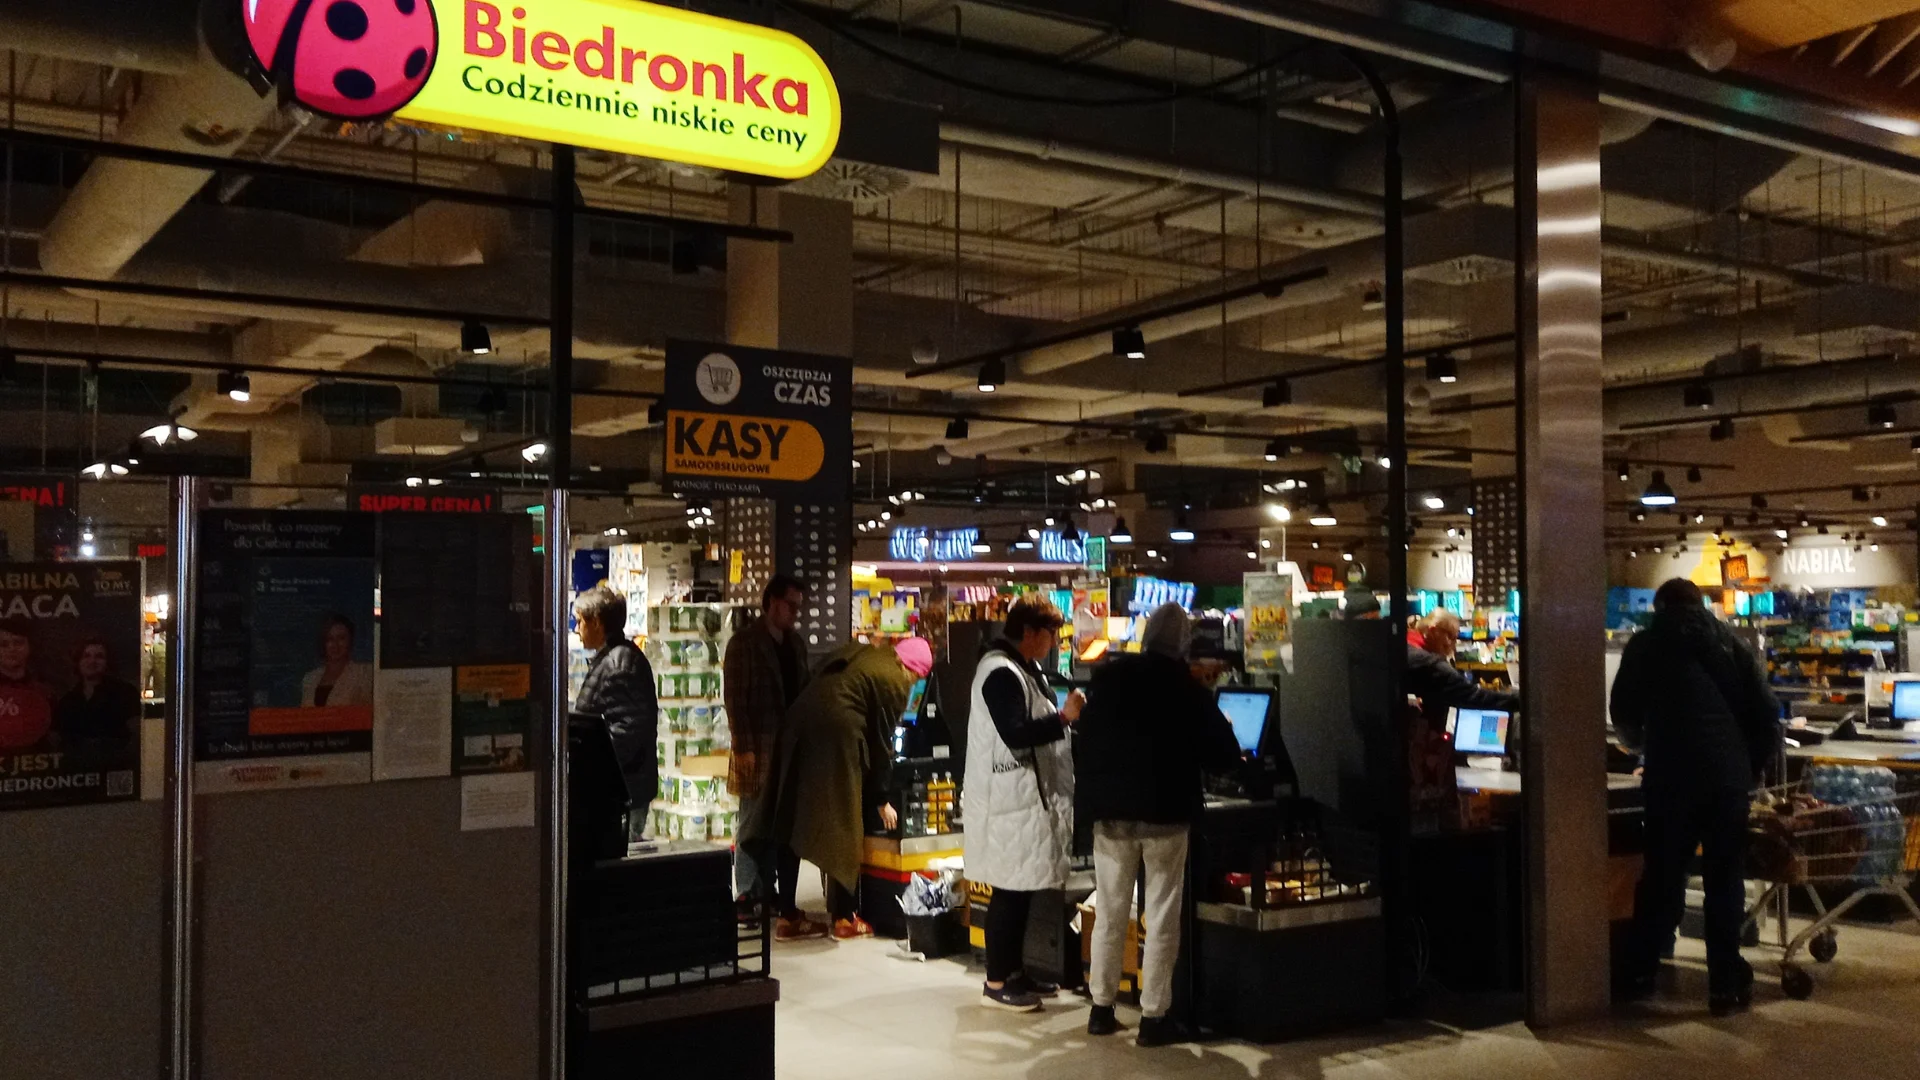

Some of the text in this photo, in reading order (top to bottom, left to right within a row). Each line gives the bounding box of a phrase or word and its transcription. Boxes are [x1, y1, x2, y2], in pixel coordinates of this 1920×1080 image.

[464, 0, 809, 117] Biedronka
[462, 63, 808, 153] Codziennie niskie ceny
[762, 364, 832, 384] OSZCZĘDZAJ
[774, 380, 832, 408] CZAS
[674, 416, 790, 462] KASY
[674, 458, 770, 475] SAMOOBSŁUGOWE
[359, 494, 493, 513] SUPER CENA!
[1783, 547, 1857, 575] NABIAŁ
[10, 751, 65, 777] JEST
